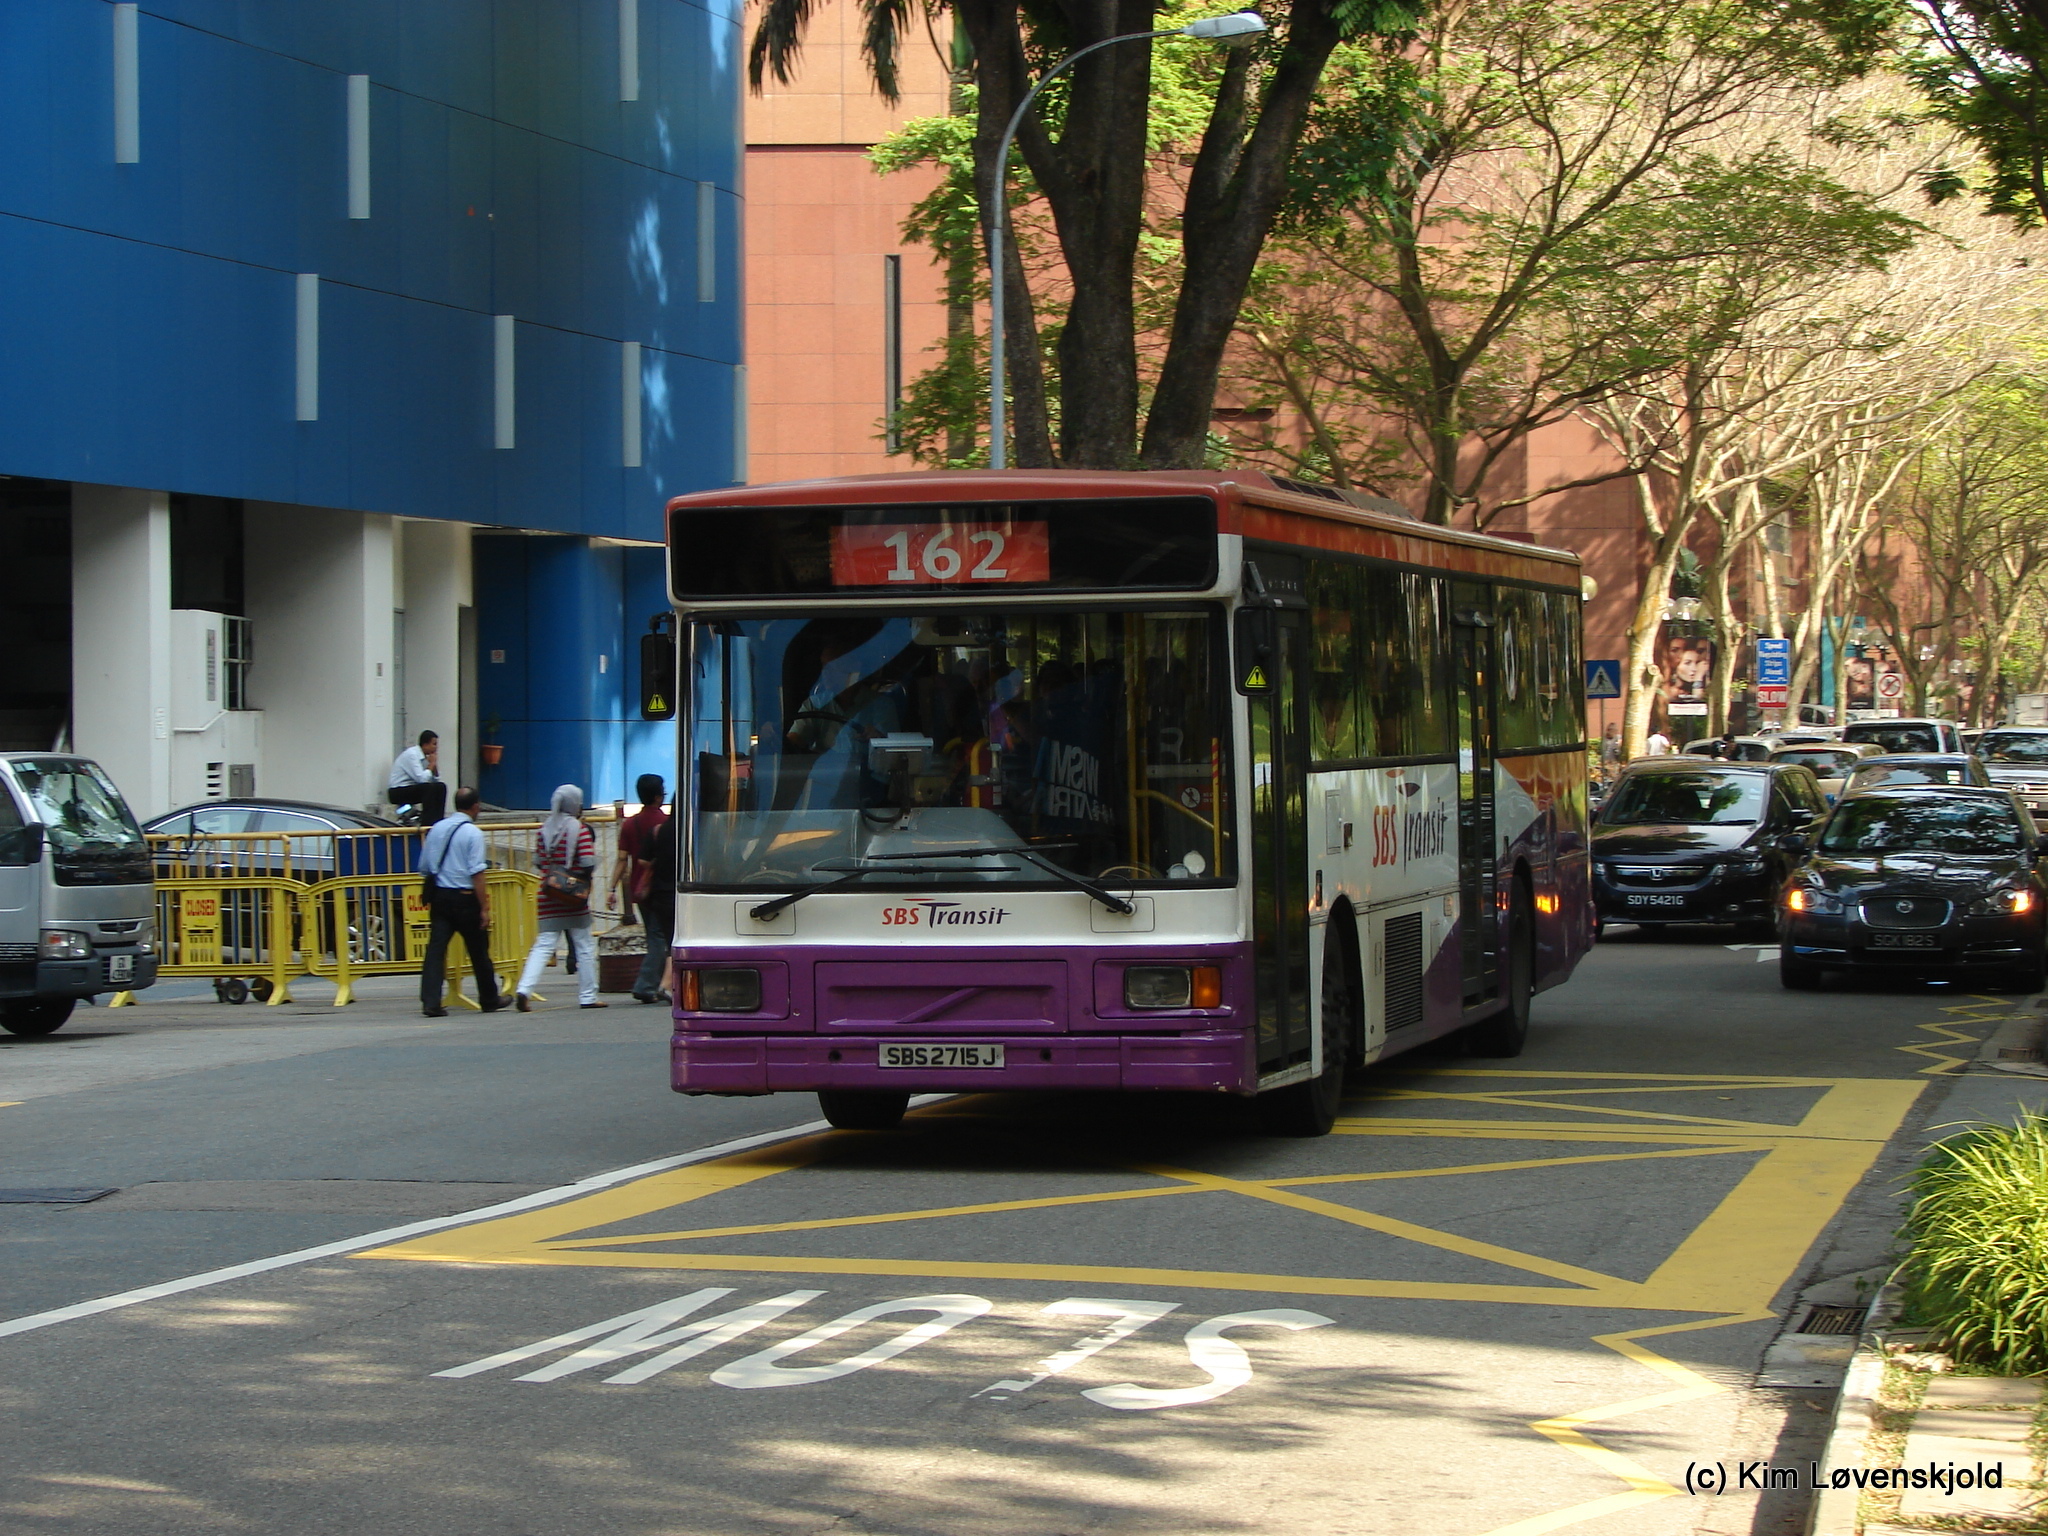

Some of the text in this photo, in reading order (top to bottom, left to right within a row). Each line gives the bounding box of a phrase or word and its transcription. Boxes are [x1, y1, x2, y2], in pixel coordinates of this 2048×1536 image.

[884, 527, 1008, 581] 162
[1372, 782, 1449, 876] SBS Transit
[881, 902, 1012, 929] SBS Transit
